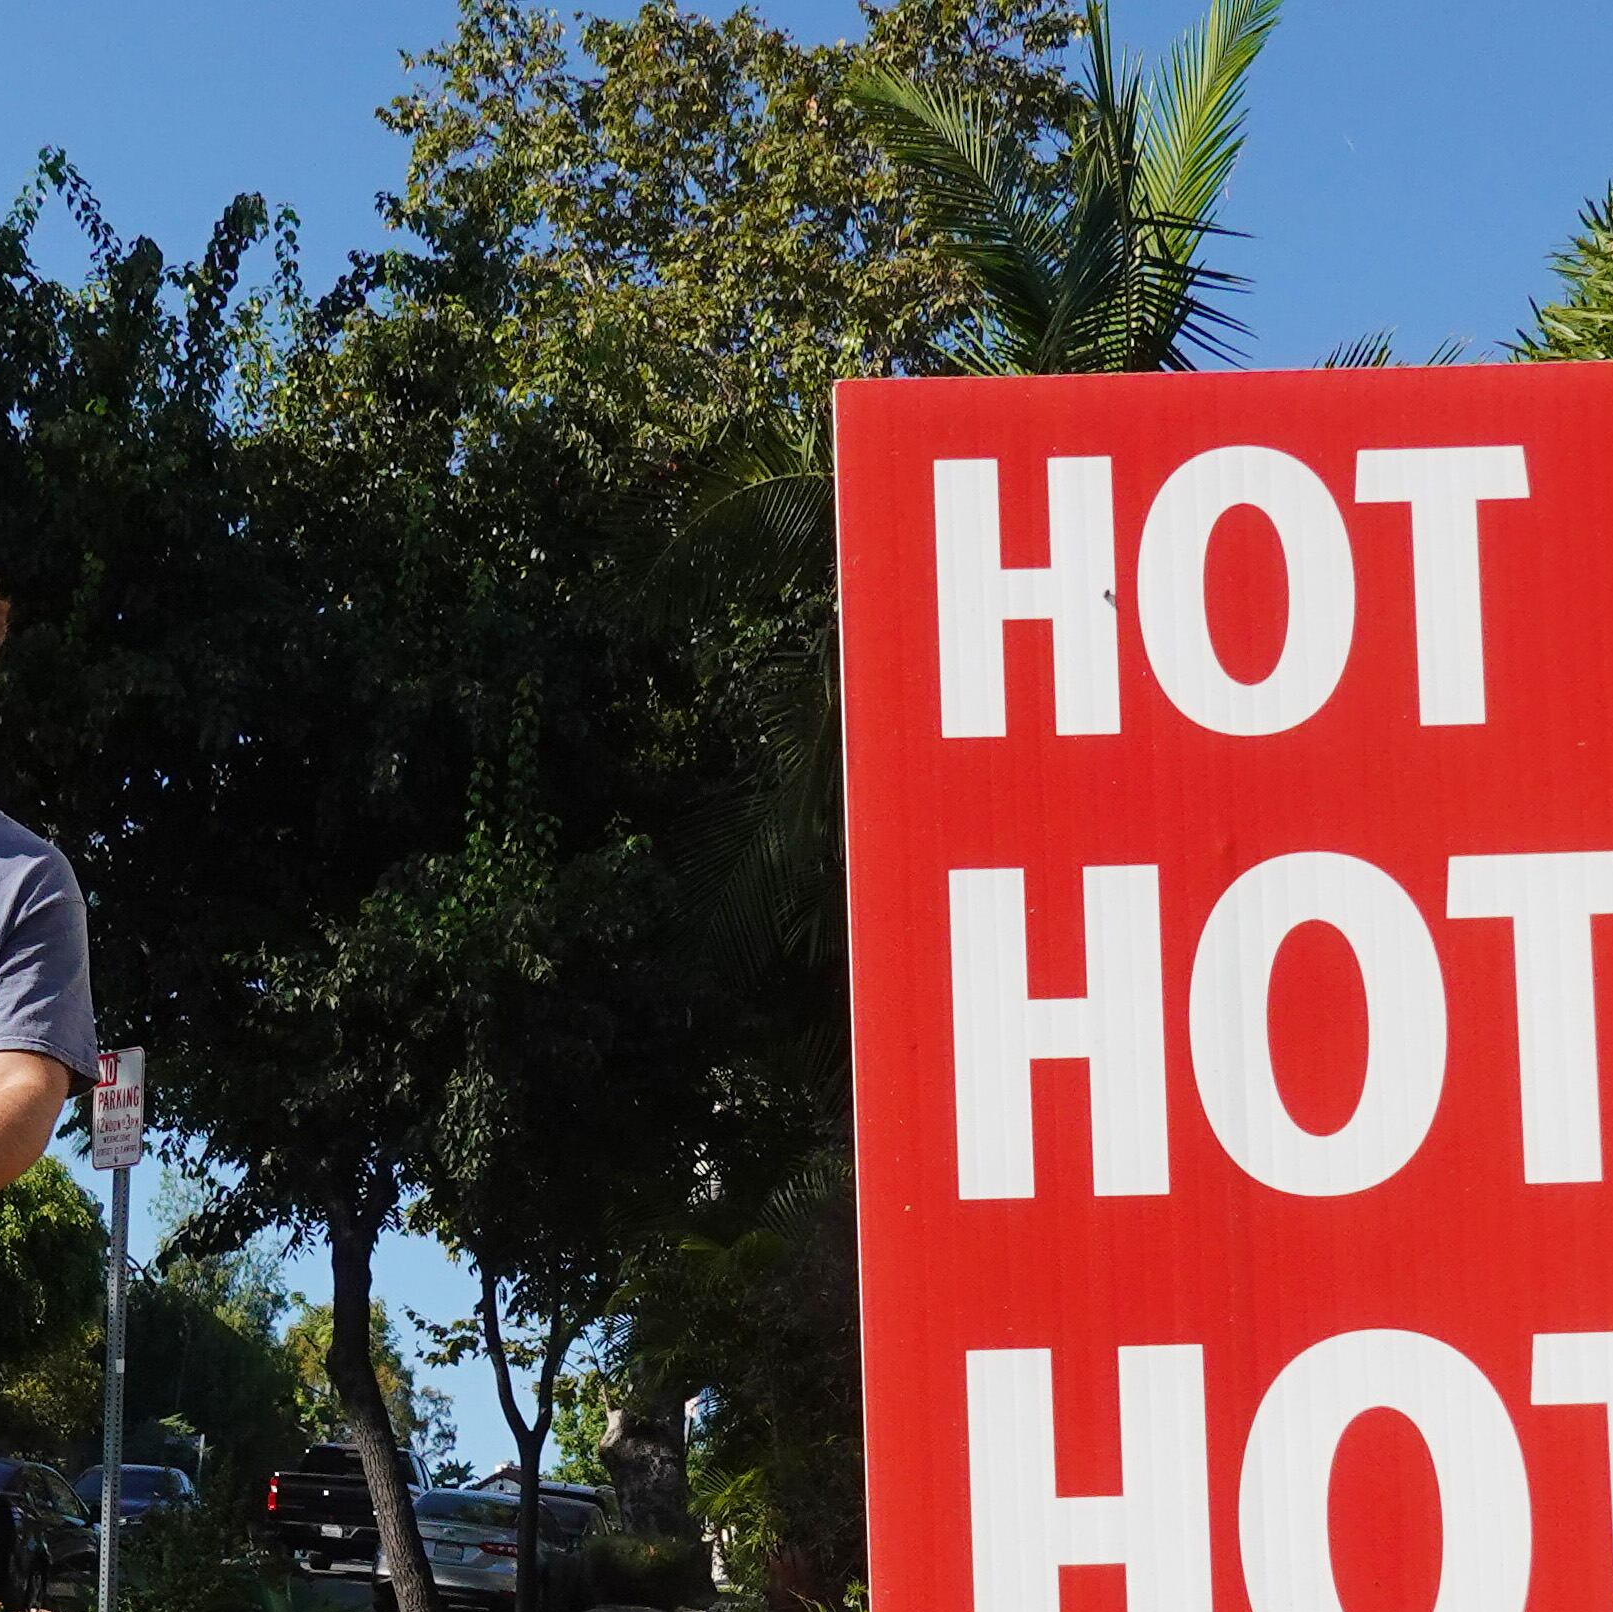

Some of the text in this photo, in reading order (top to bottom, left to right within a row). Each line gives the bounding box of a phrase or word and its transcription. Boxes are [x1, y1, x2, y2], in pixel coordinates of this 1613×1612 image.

[934, 445, 1530, 738] HOT
[99, 1058, 115, 1083] NO
[98, 1087, 139, 1110] PARKING
